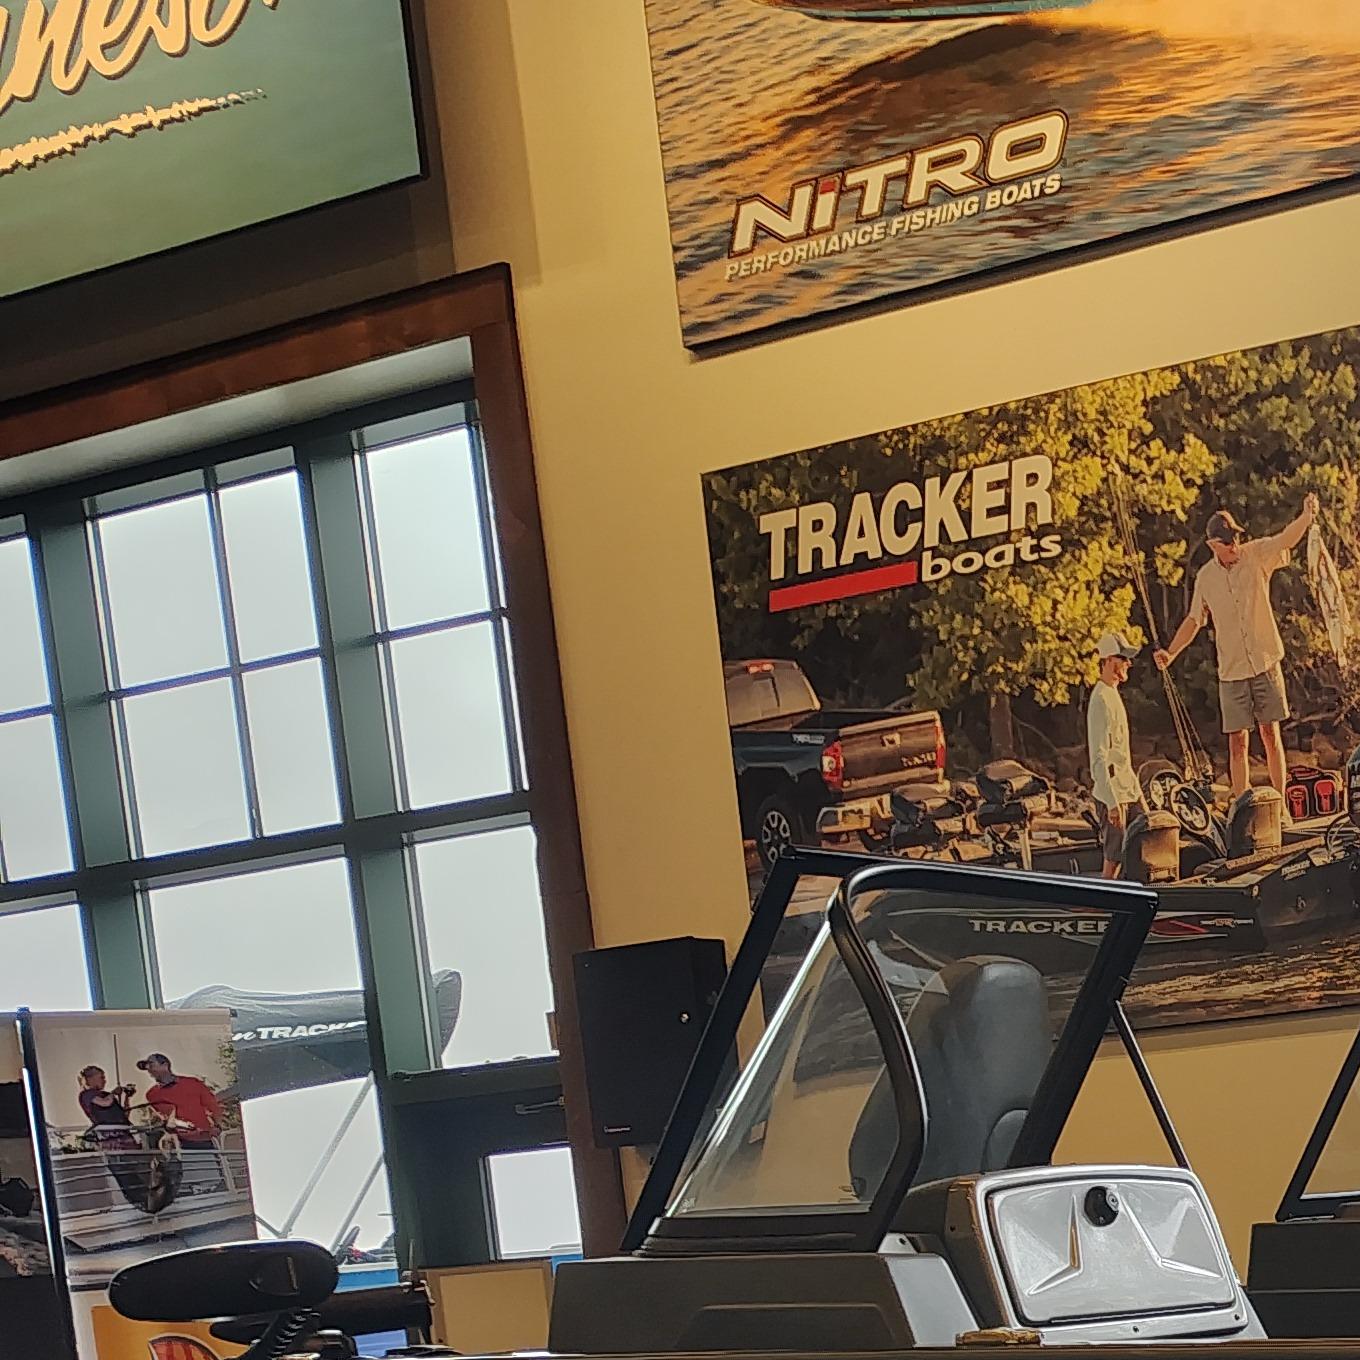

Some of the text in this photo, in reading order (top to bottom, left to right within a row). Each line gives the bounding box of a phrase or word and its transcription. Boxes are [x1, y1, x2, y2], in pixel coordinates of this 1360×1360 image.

[724, 173, 1063, 282] PERFORMANCE FISHING BOATS
[759, 454, 1053, 581] TRACKER
[921, 533, 1063, 582] boats
